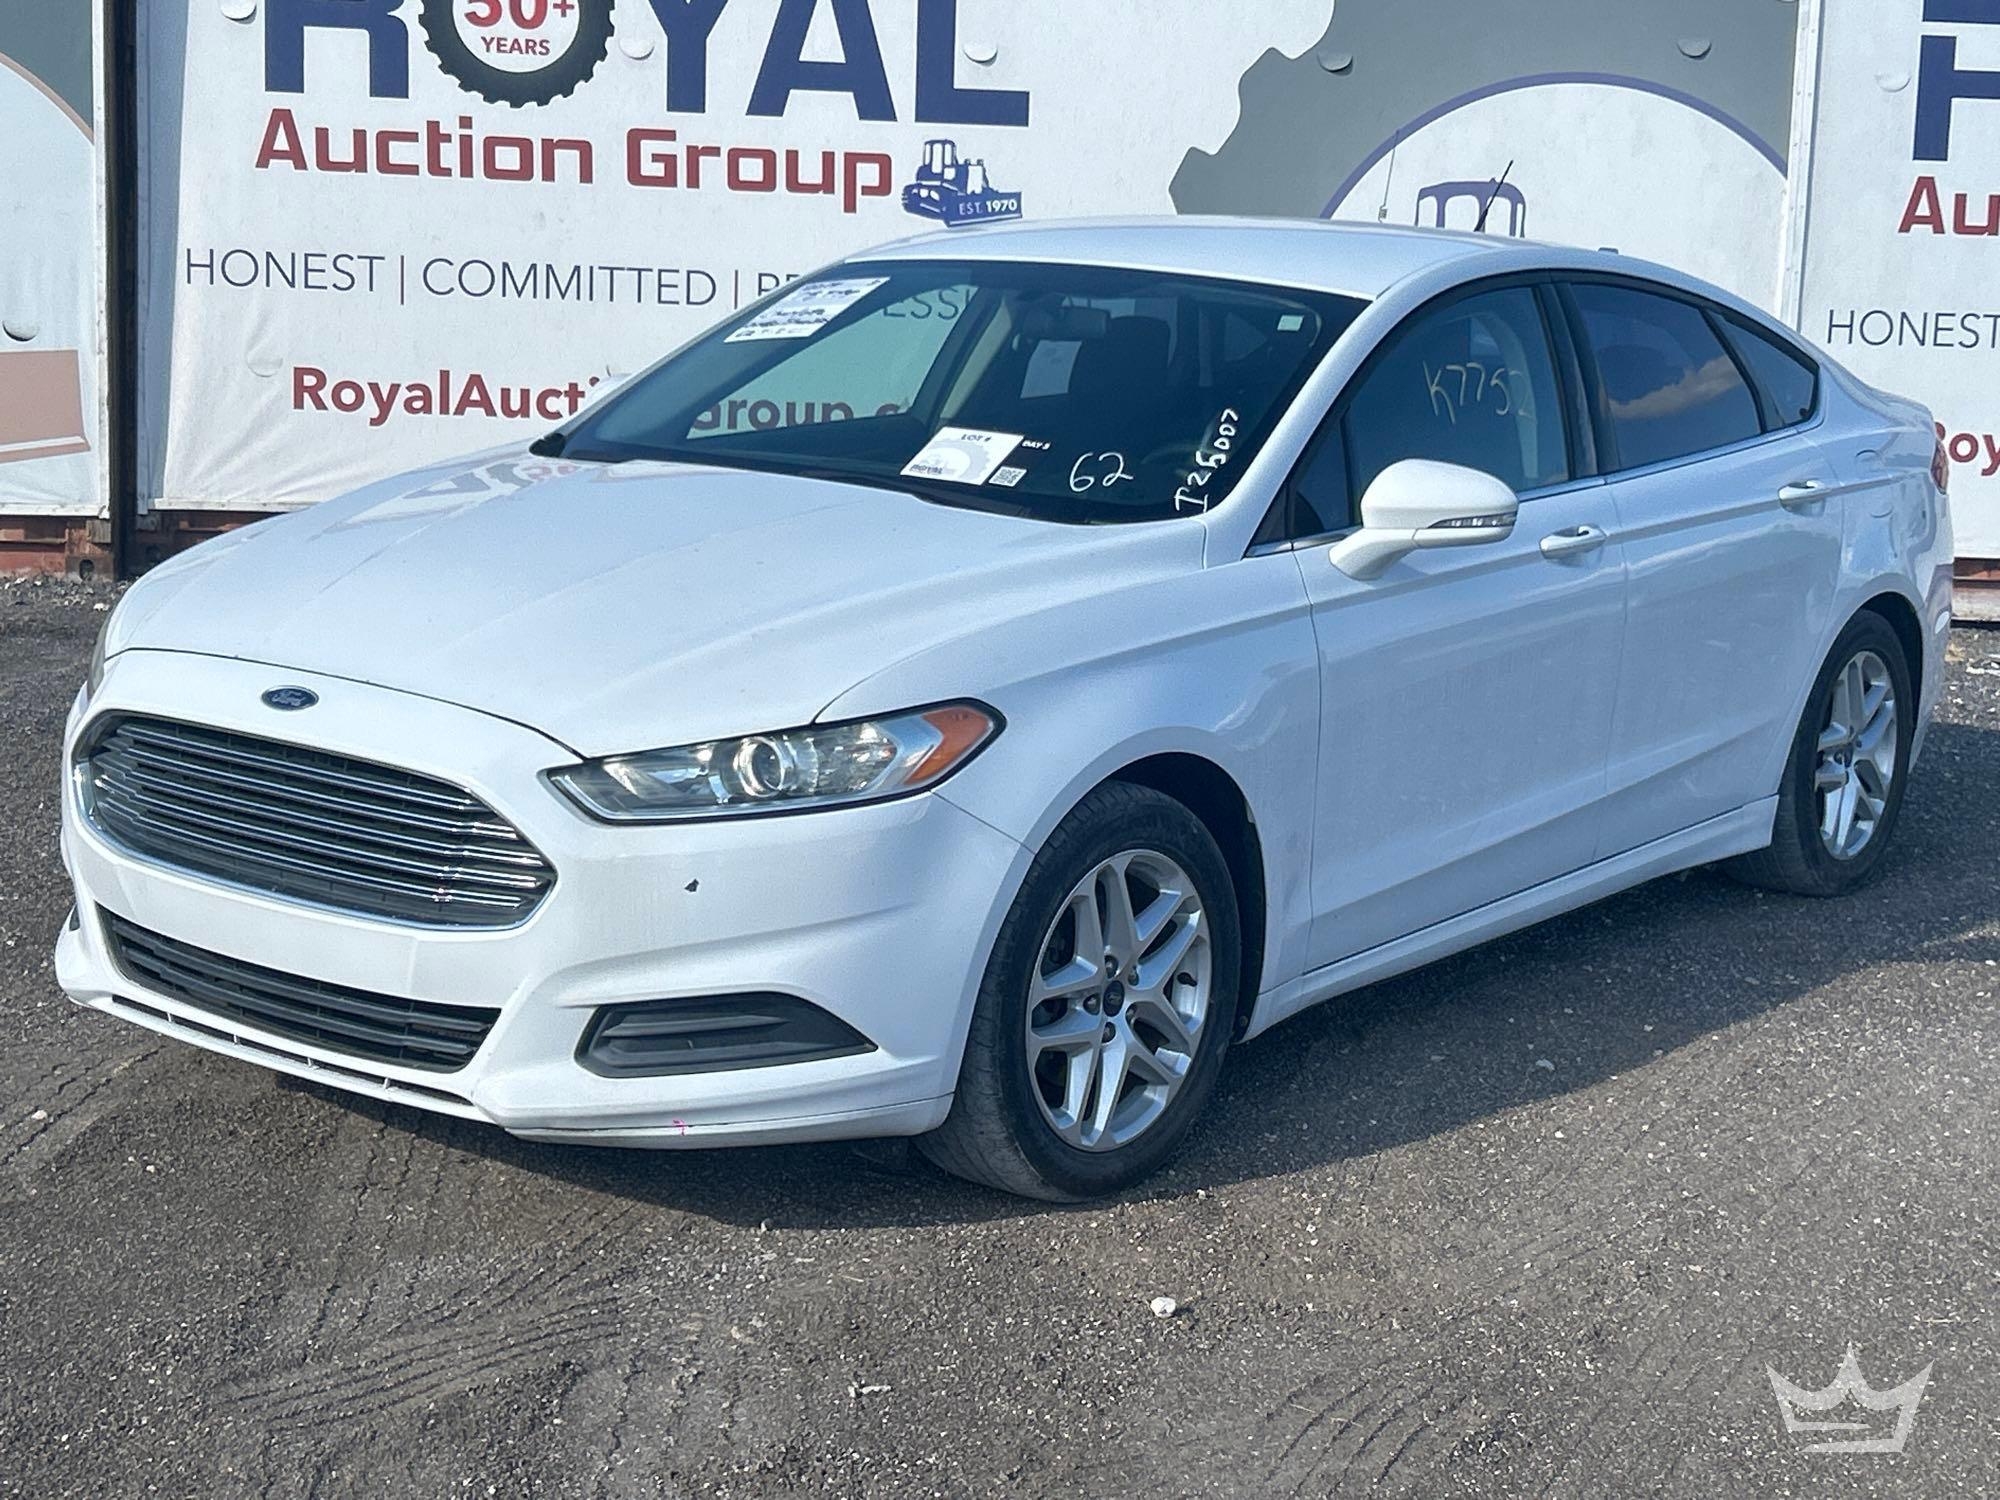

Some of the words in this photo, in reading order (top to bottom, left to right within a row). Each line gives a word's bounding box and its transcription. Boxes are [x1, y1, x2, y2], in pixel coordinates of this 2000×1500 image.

[481, 36, 551, 56] YEARS
[255, 108, 593, 184] Auction
[626, 128, 892, 213] Group
[986, 199, 1018, 213] 1970
[185, 248, 386, 292] HONEST
[423, 258, 717, 307] COMMITTED
[1827, 310, 2000, 349] HONEST
[293, 366, 600, 427] RoyalAuct
[1069, 452, 1133, 493] 62
